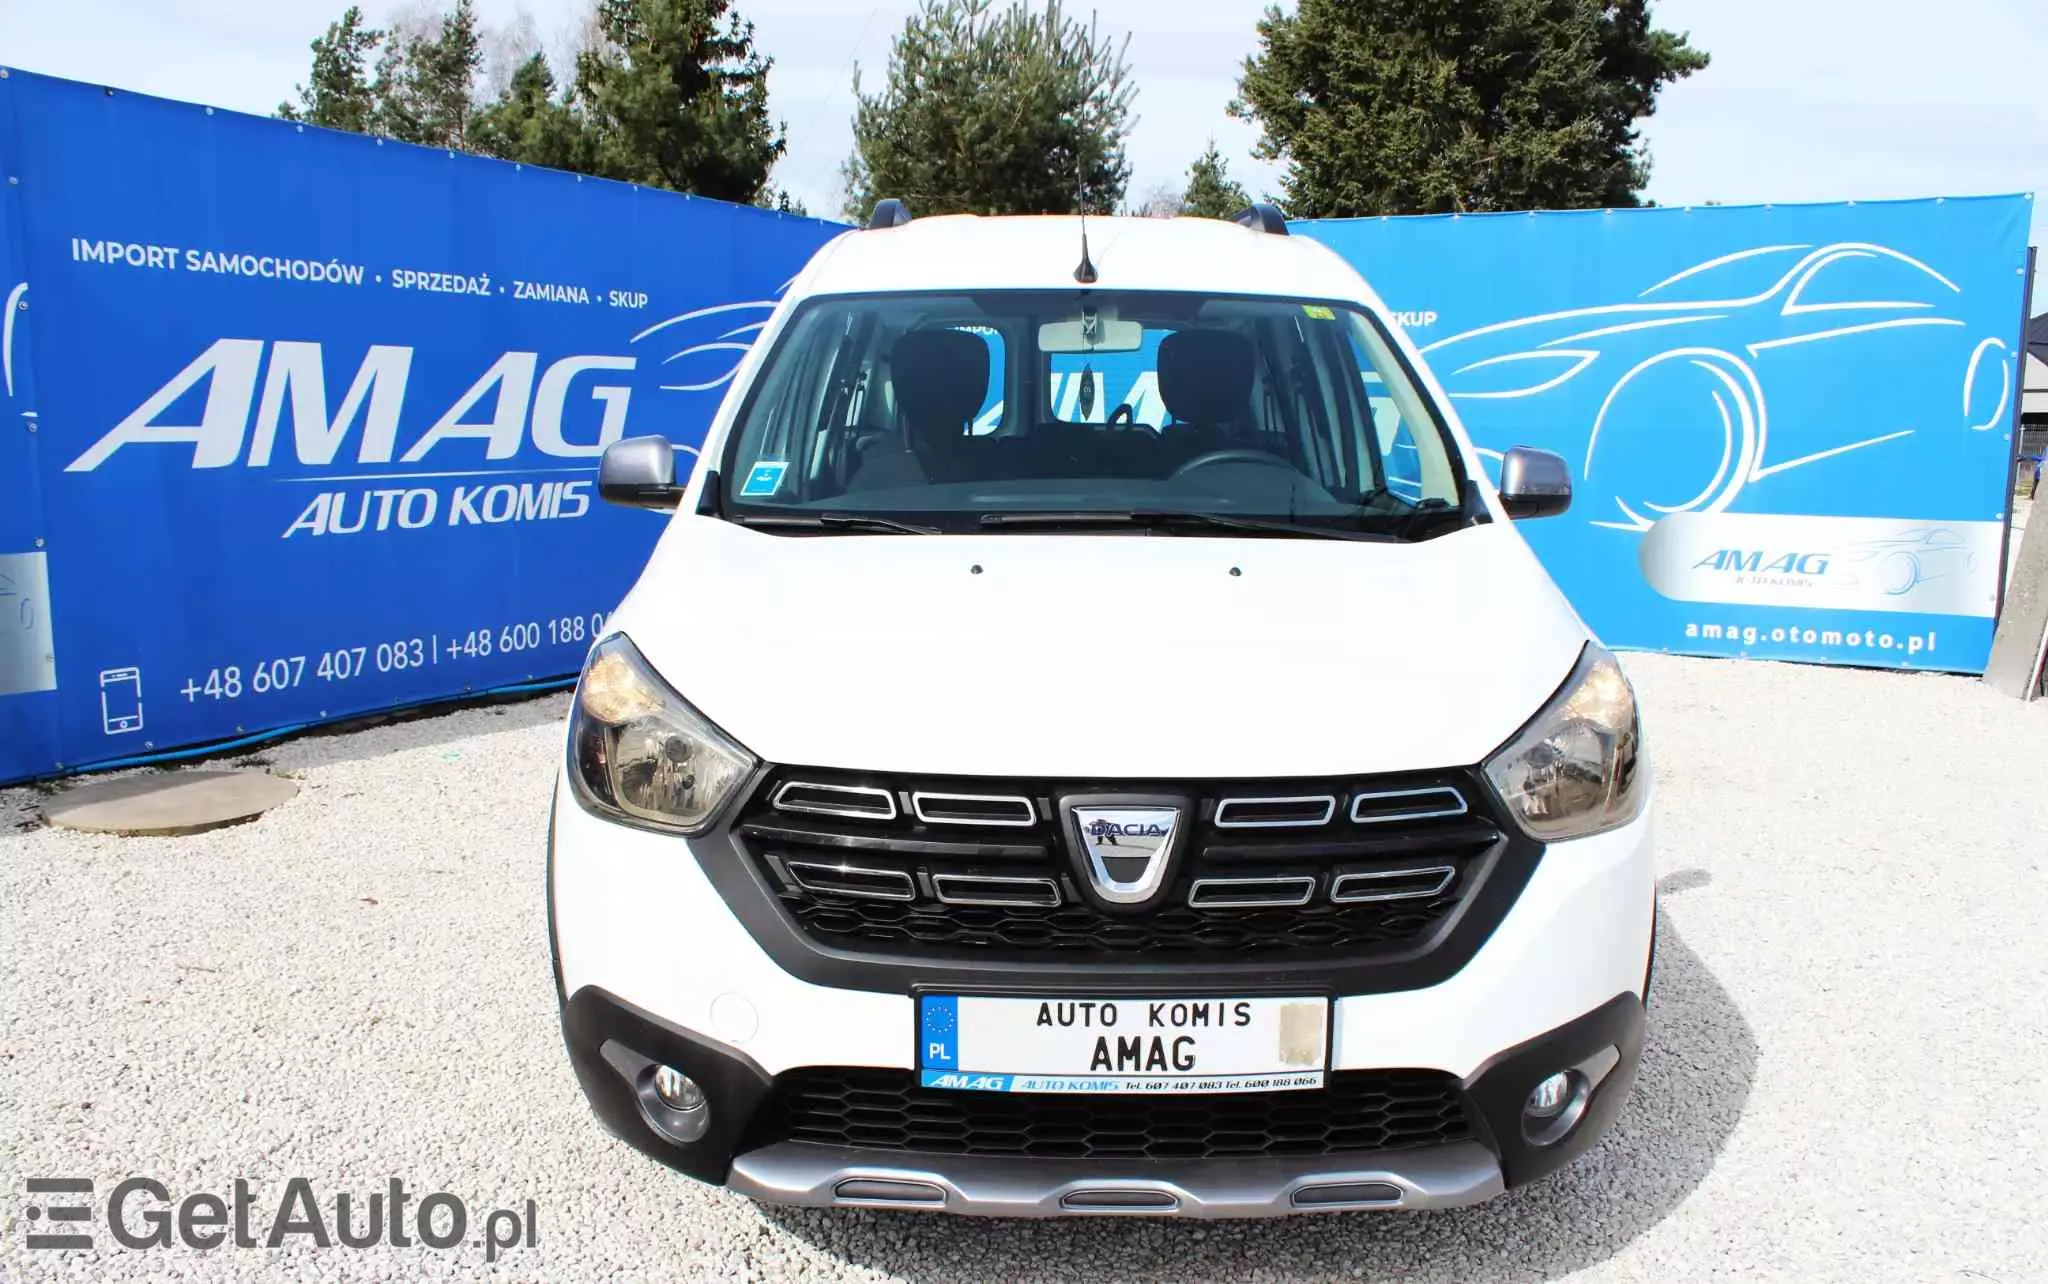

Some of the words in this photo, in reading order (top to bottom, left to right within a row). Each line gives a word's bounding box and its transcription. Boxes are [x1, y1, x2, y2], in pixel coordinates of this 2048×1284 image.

[72, 238, 179, 269] IMPORT
[186, 250, 364, 285] SAMOCHODÓW
[392, 269, 491, 296] SPRZEDAŻ
[513, 281, 589, 304] ZAMIANA
[609, 290, 648, 309] SKUP
[282, 489, 437, 538] AUTO
[449, 481, 592, 526] KOMIS
[1685, 623, 1936, 654] amag.otomoto.pl
[180, 666, 242, 702] +48
[252, 656, 306, 693] 607
[317, 647, 367, 680] 407
[376, 638, 424, 672] 083
[446, 629, 492, 659] +48
[499, 622, 541, 652] 600
[548, 616, 584, 645] 188
[1091, 823, 1161, 836] DACIA
[1036, 1002, 1118, 1027] AUTO
[1149, 1002, 1251, 1026] KOMIS
[929, 1043, 951, 1060] PL
[1090, 1035, 1196, 1072] AMAG
[1021, 1080, 1064, 1090] AUTO
